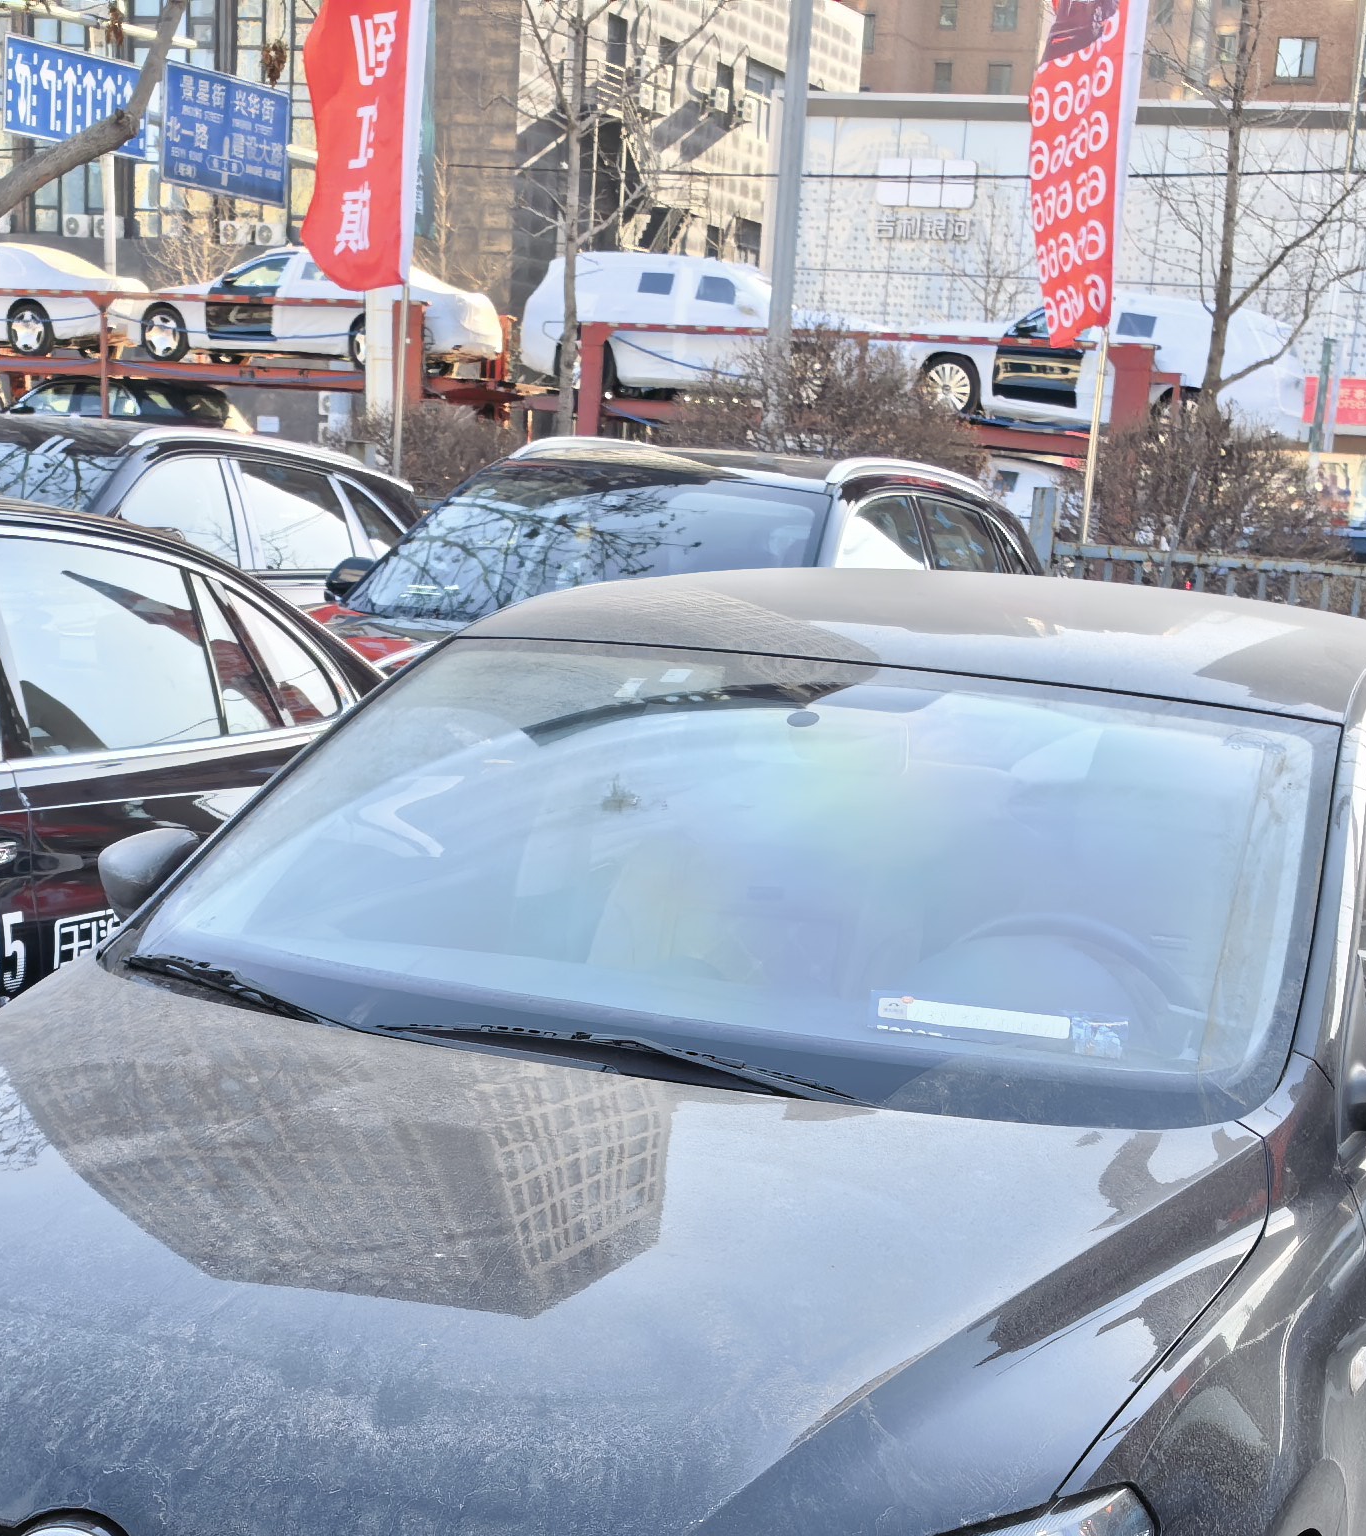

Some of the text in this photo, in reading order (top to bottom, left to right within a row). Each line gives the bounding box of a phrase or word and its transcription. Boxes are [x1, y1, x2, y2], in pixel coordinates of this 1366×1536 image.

[230, 89, 275, 124] 兴华街
[166, 115, 209, 150] 北一路
[875, 213, 972, 241] 吉利银河
